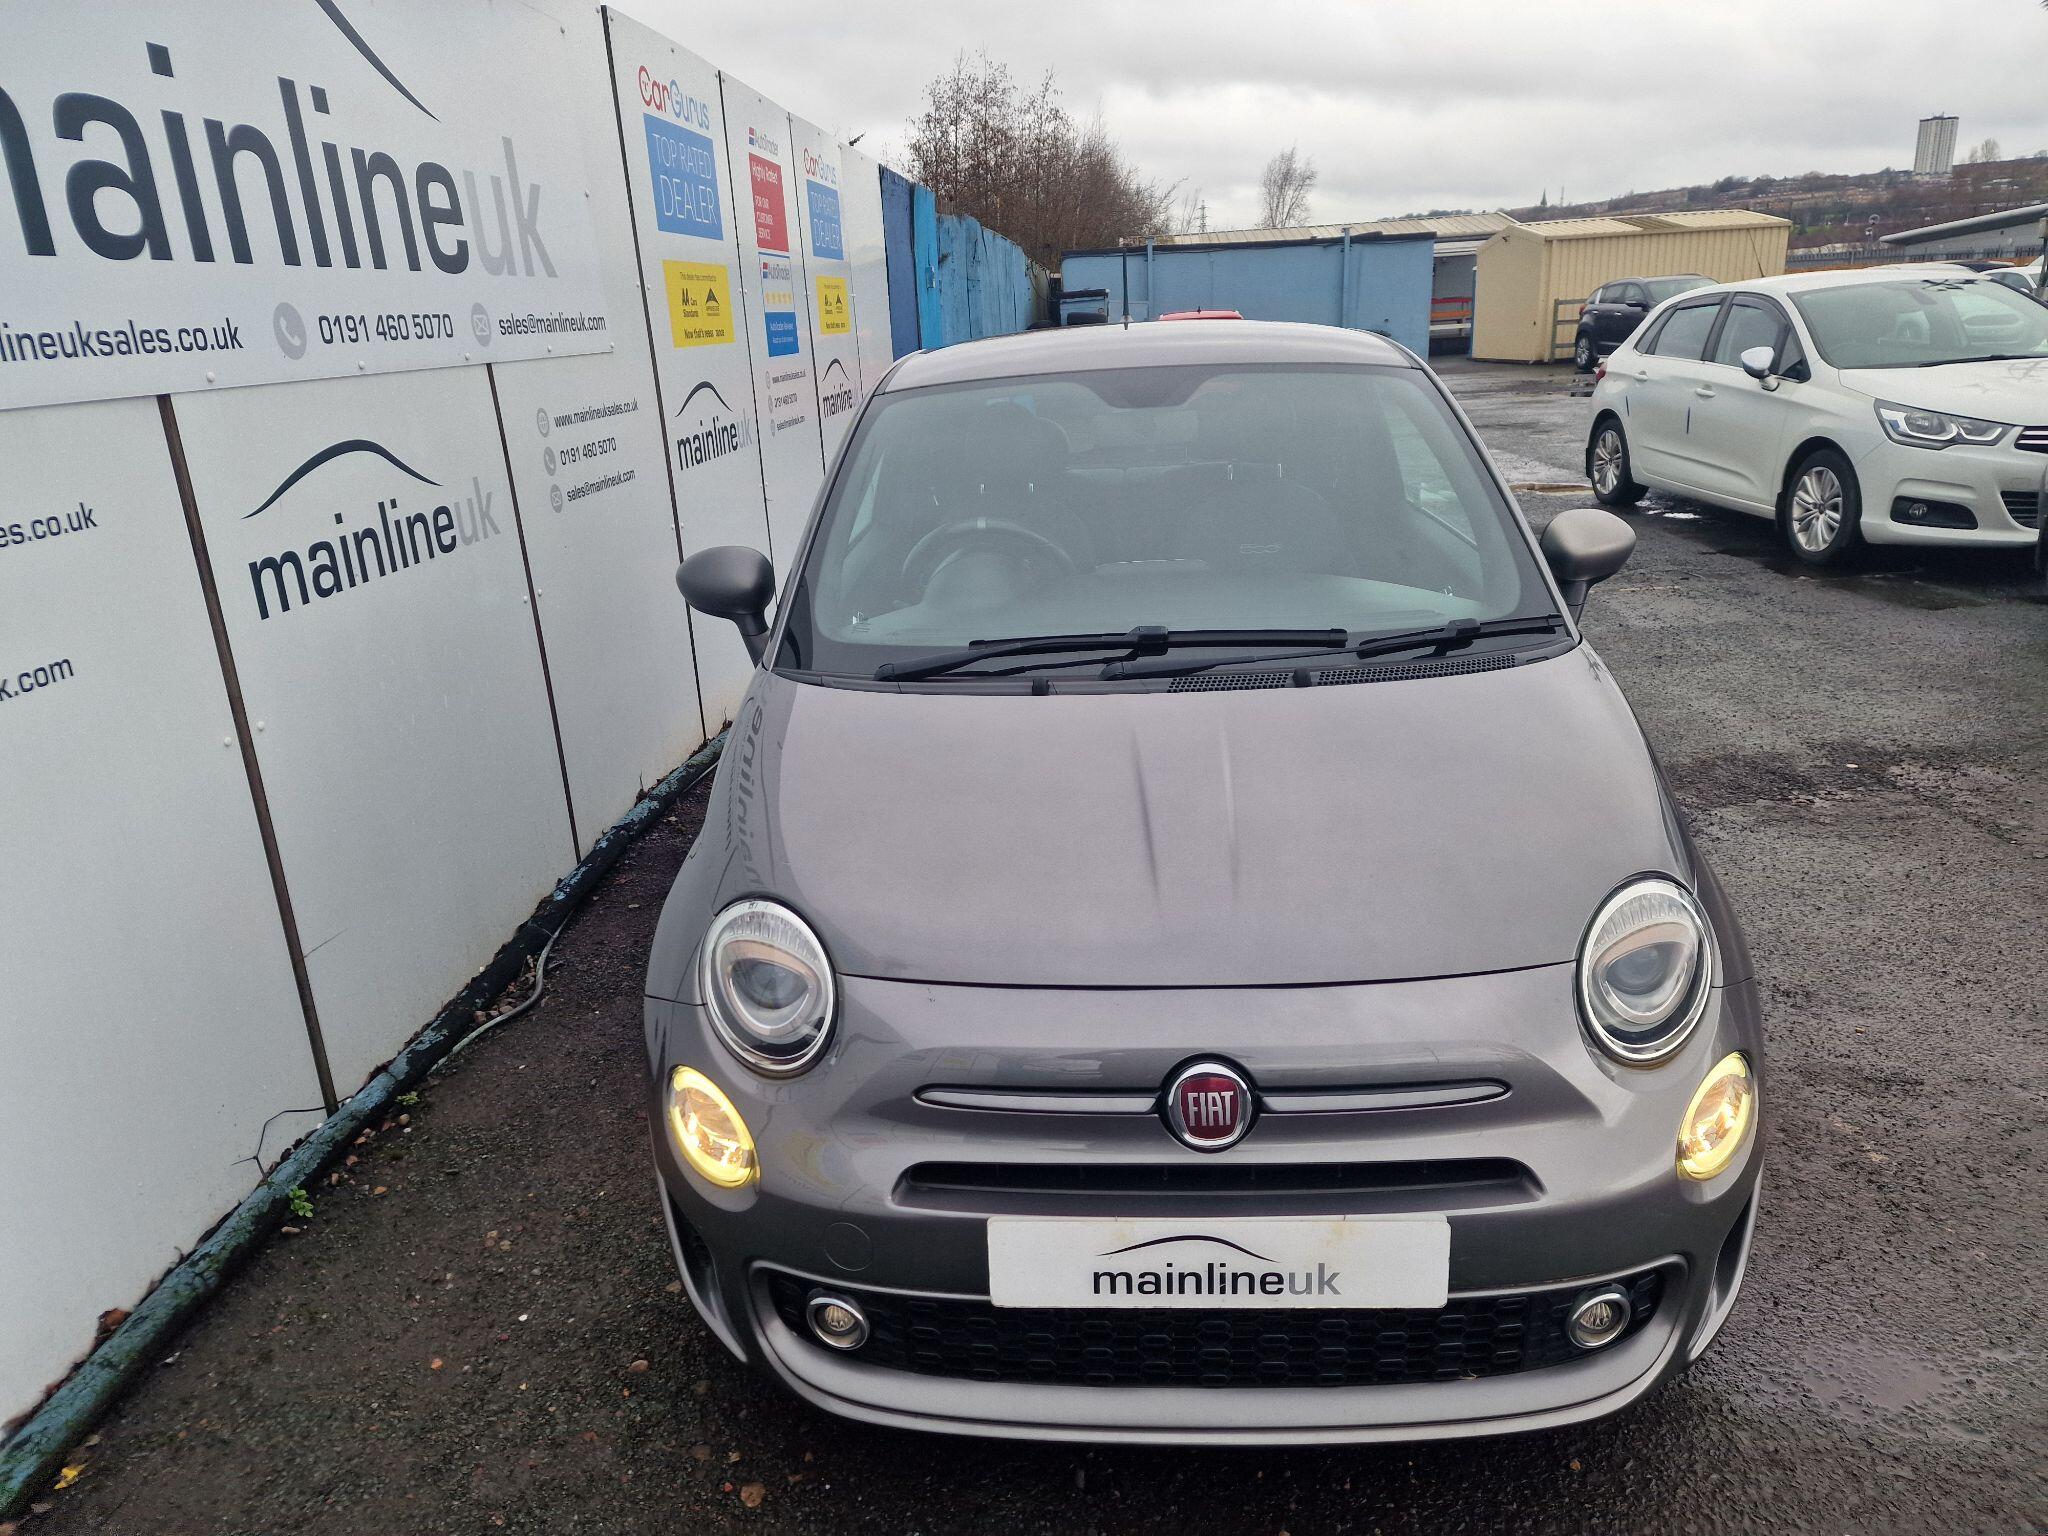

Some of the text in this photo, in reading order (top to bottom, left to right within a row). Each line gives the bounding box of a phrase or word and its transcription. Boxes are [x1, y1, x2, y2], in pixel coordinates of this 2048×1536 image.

[638, 65, 710, 130] CarGurus
[652, 133, 713, 179] TOP RATED
[660, 174, 718, 225] DEALER
[318, 313, 454, 344] 0191 460 5070
[498, 311, 607, 336] sales@mainlineuk.com
[553, 396, 640, 428] www.mainlineuksales.co.uk
[560, 436, 617, 466] 0191 460 5070
[677, 407, 753, 470] mainlineuk
[566, 469, 637, 502] sales@mainlineuk.com
[0, 502, 98, 547] es.co.uk
[248, 476, 501, 620] mainlineuk
[1187, 1091, 1234, 1127] FIAT
[1093, 1262, 1341, 1296] mainlineuk
